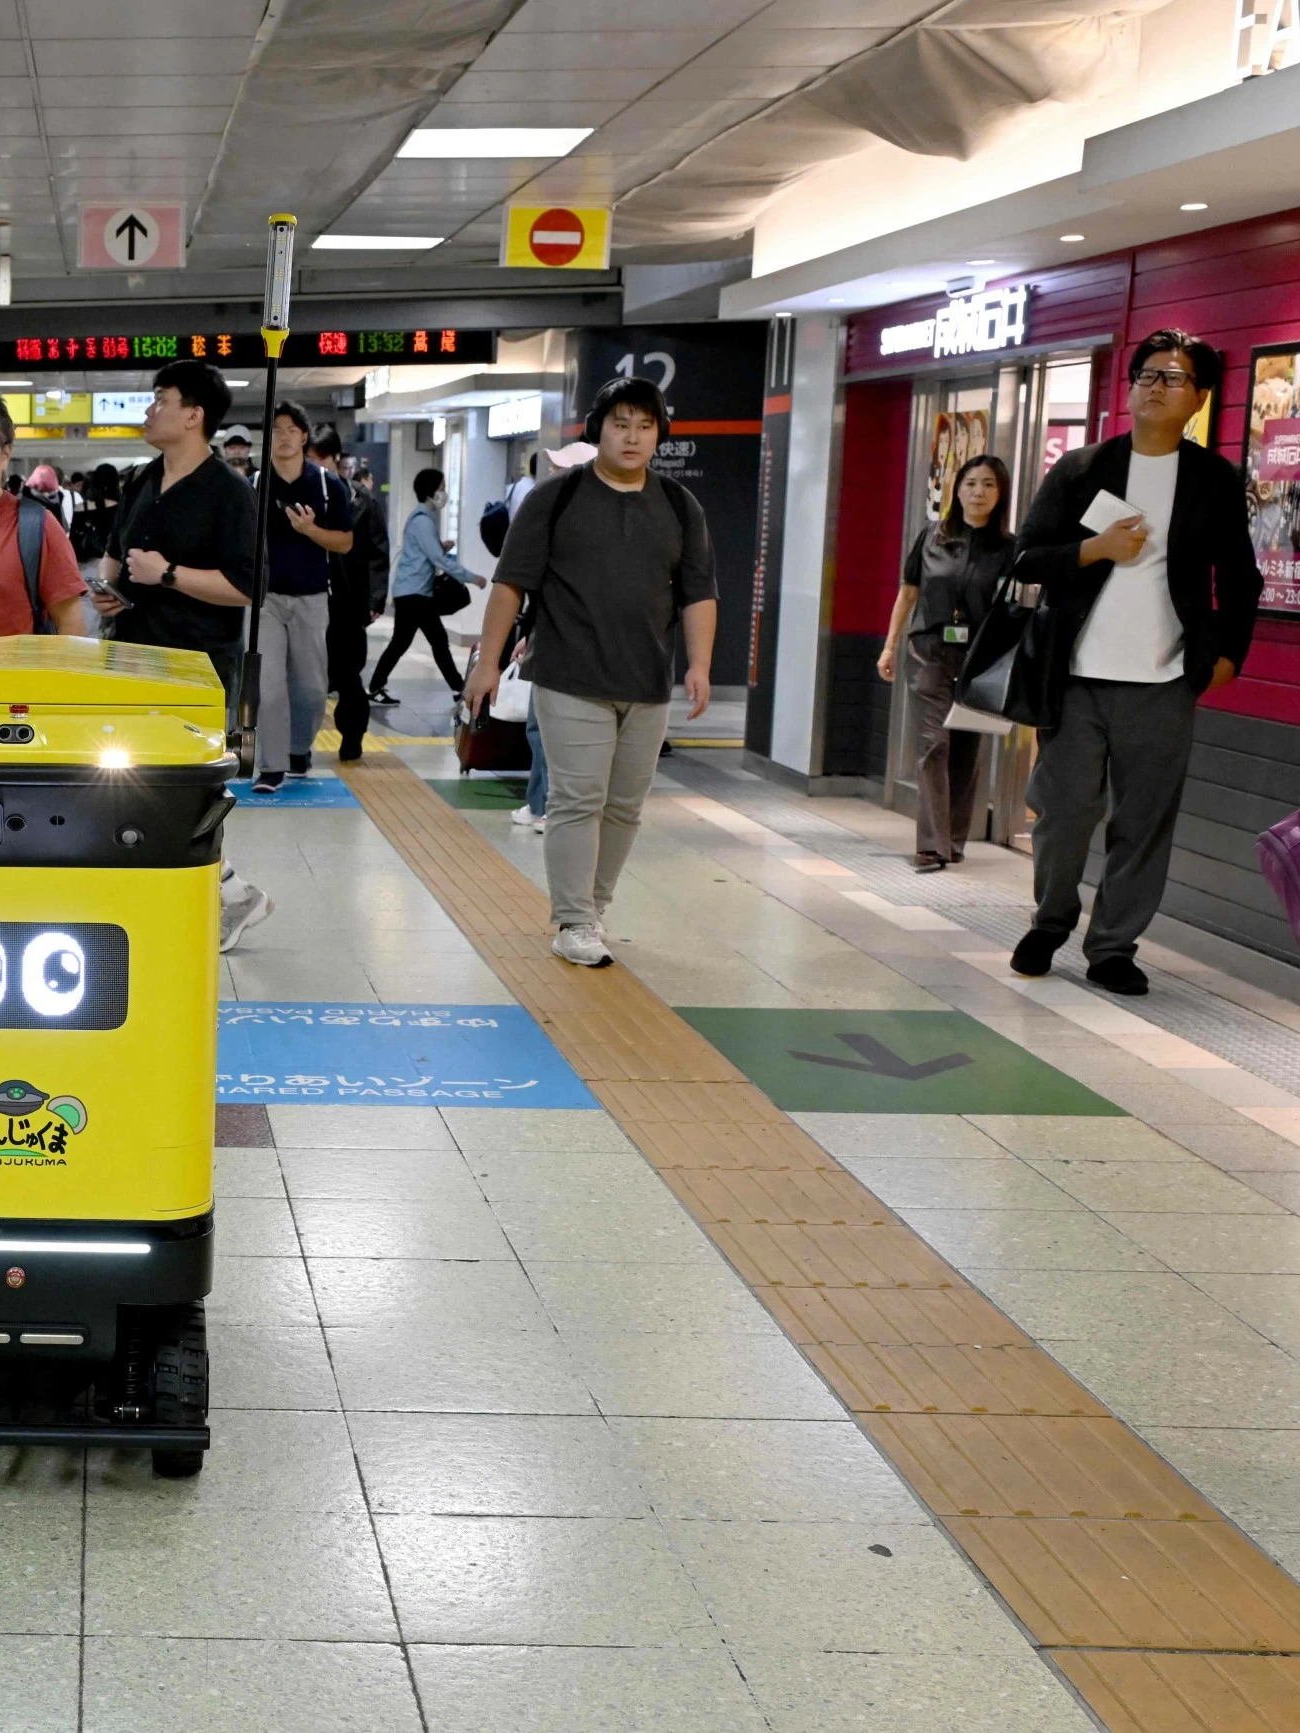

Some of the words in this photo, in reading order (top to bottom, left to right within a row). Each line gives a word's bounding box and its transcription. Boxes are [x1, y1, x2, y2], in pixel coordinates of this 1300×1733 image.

[133, 337, 177, 357] 15:02
[319, 332, 348, 355] 快速
[217, 1007, 313, 1015] PASSA
[337, 1088, 505, 1099] PASSAGE
